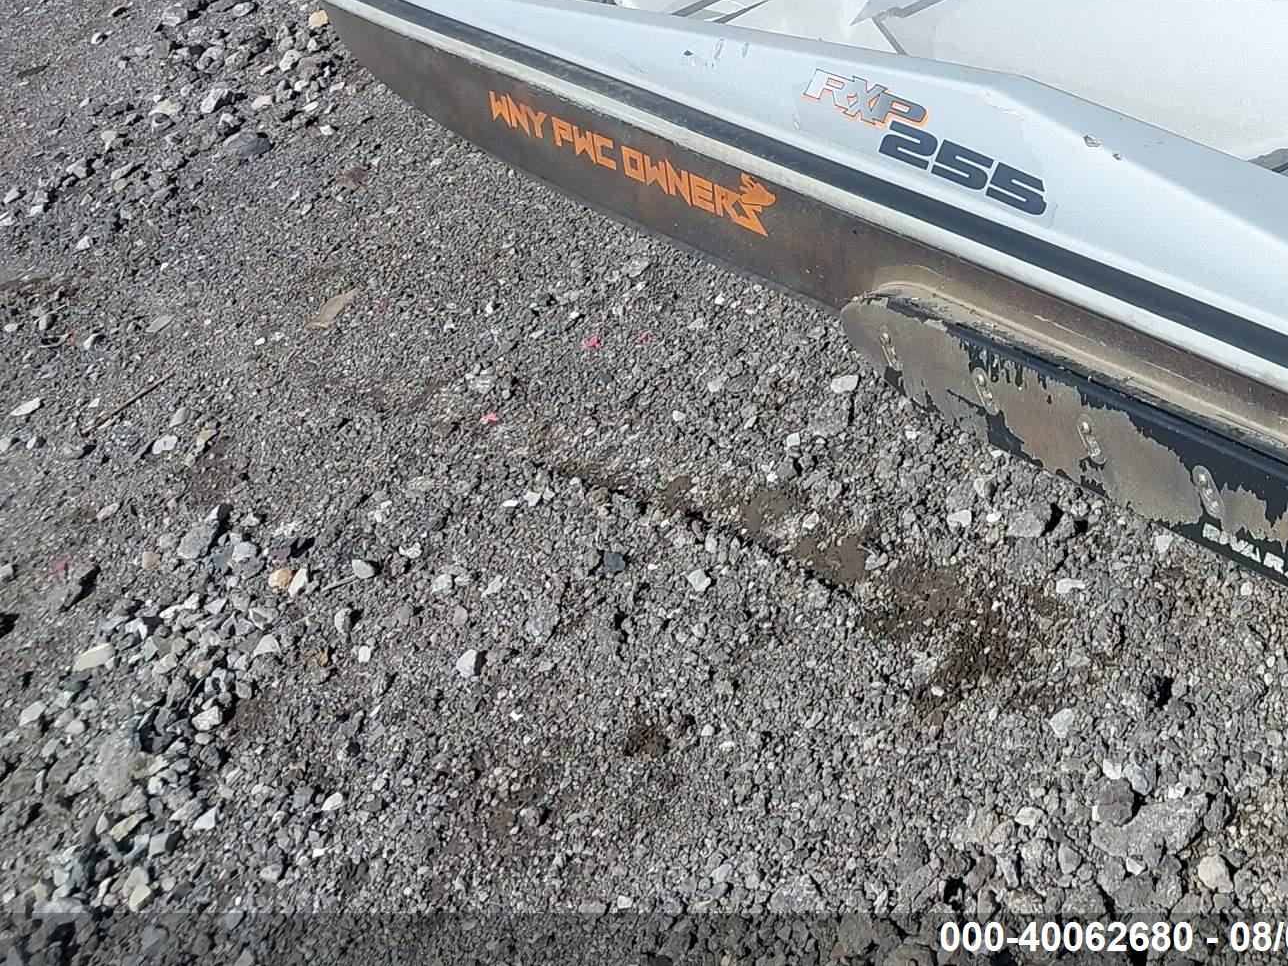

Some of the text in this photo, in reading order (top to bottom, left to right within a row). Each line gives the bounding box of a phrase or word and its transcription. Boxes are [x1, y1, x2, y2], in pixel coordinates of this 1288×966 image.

[489, 90, 548, 139] WNY
[551, 116, 617, 171] PWC
[802, 68, 929, 128] RXP
[878, 120, 1048, 216] 255
